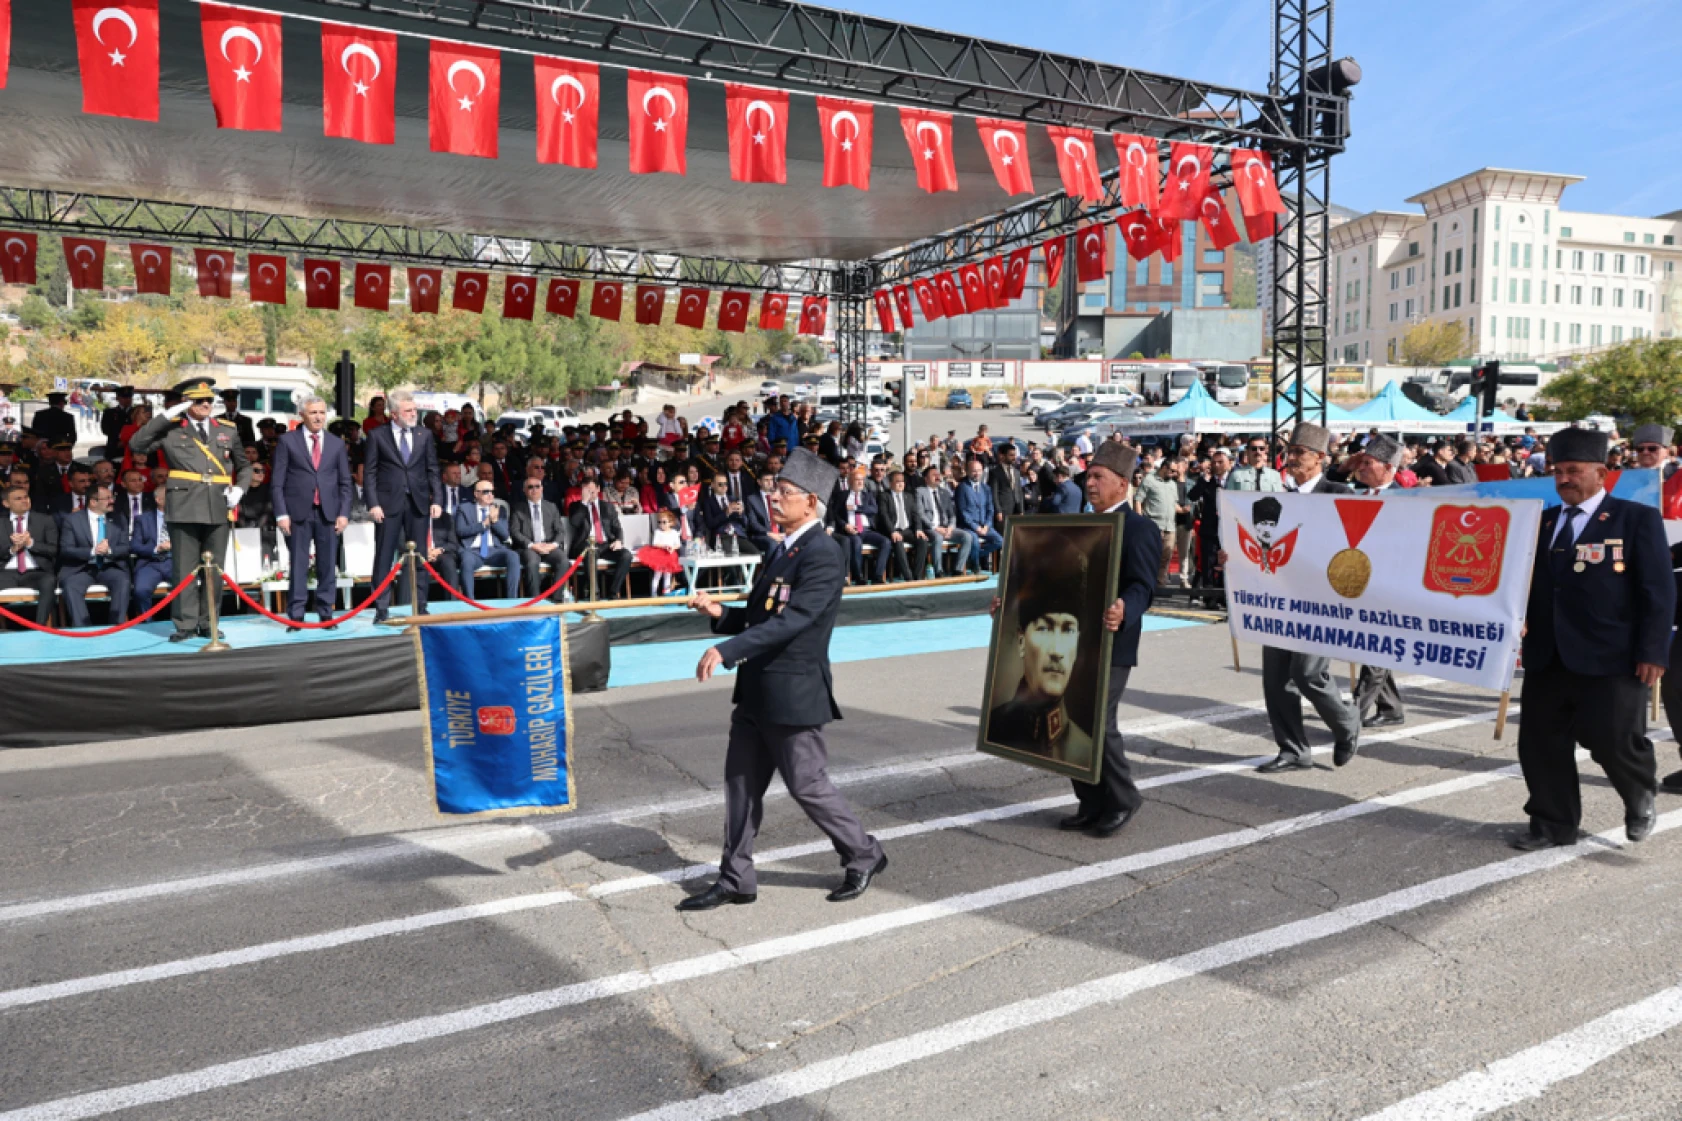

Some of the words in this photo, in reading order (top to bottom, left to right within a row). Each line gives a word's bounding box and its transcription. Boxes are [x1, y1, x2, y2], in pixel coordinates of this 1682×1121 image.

[1234, 590, 1285, 611] TÜRKİYE
[1290, 599, 1354, 620] MUHARİP
[1359, 609, 1423, 632] GAZİLER
[1429, 618, 1505, 642] DERNEĞİ
[1243, 613, 1406, 663] KAHRAMANMARAŞ
[1412, 640, 1487, 671] ŞUBESİ
[518, 644, 554, 715] GAZİLERİ
[439, 690, 476, 748] TÜRKİYE
[523, 718, 558, 781] MUHARİP
